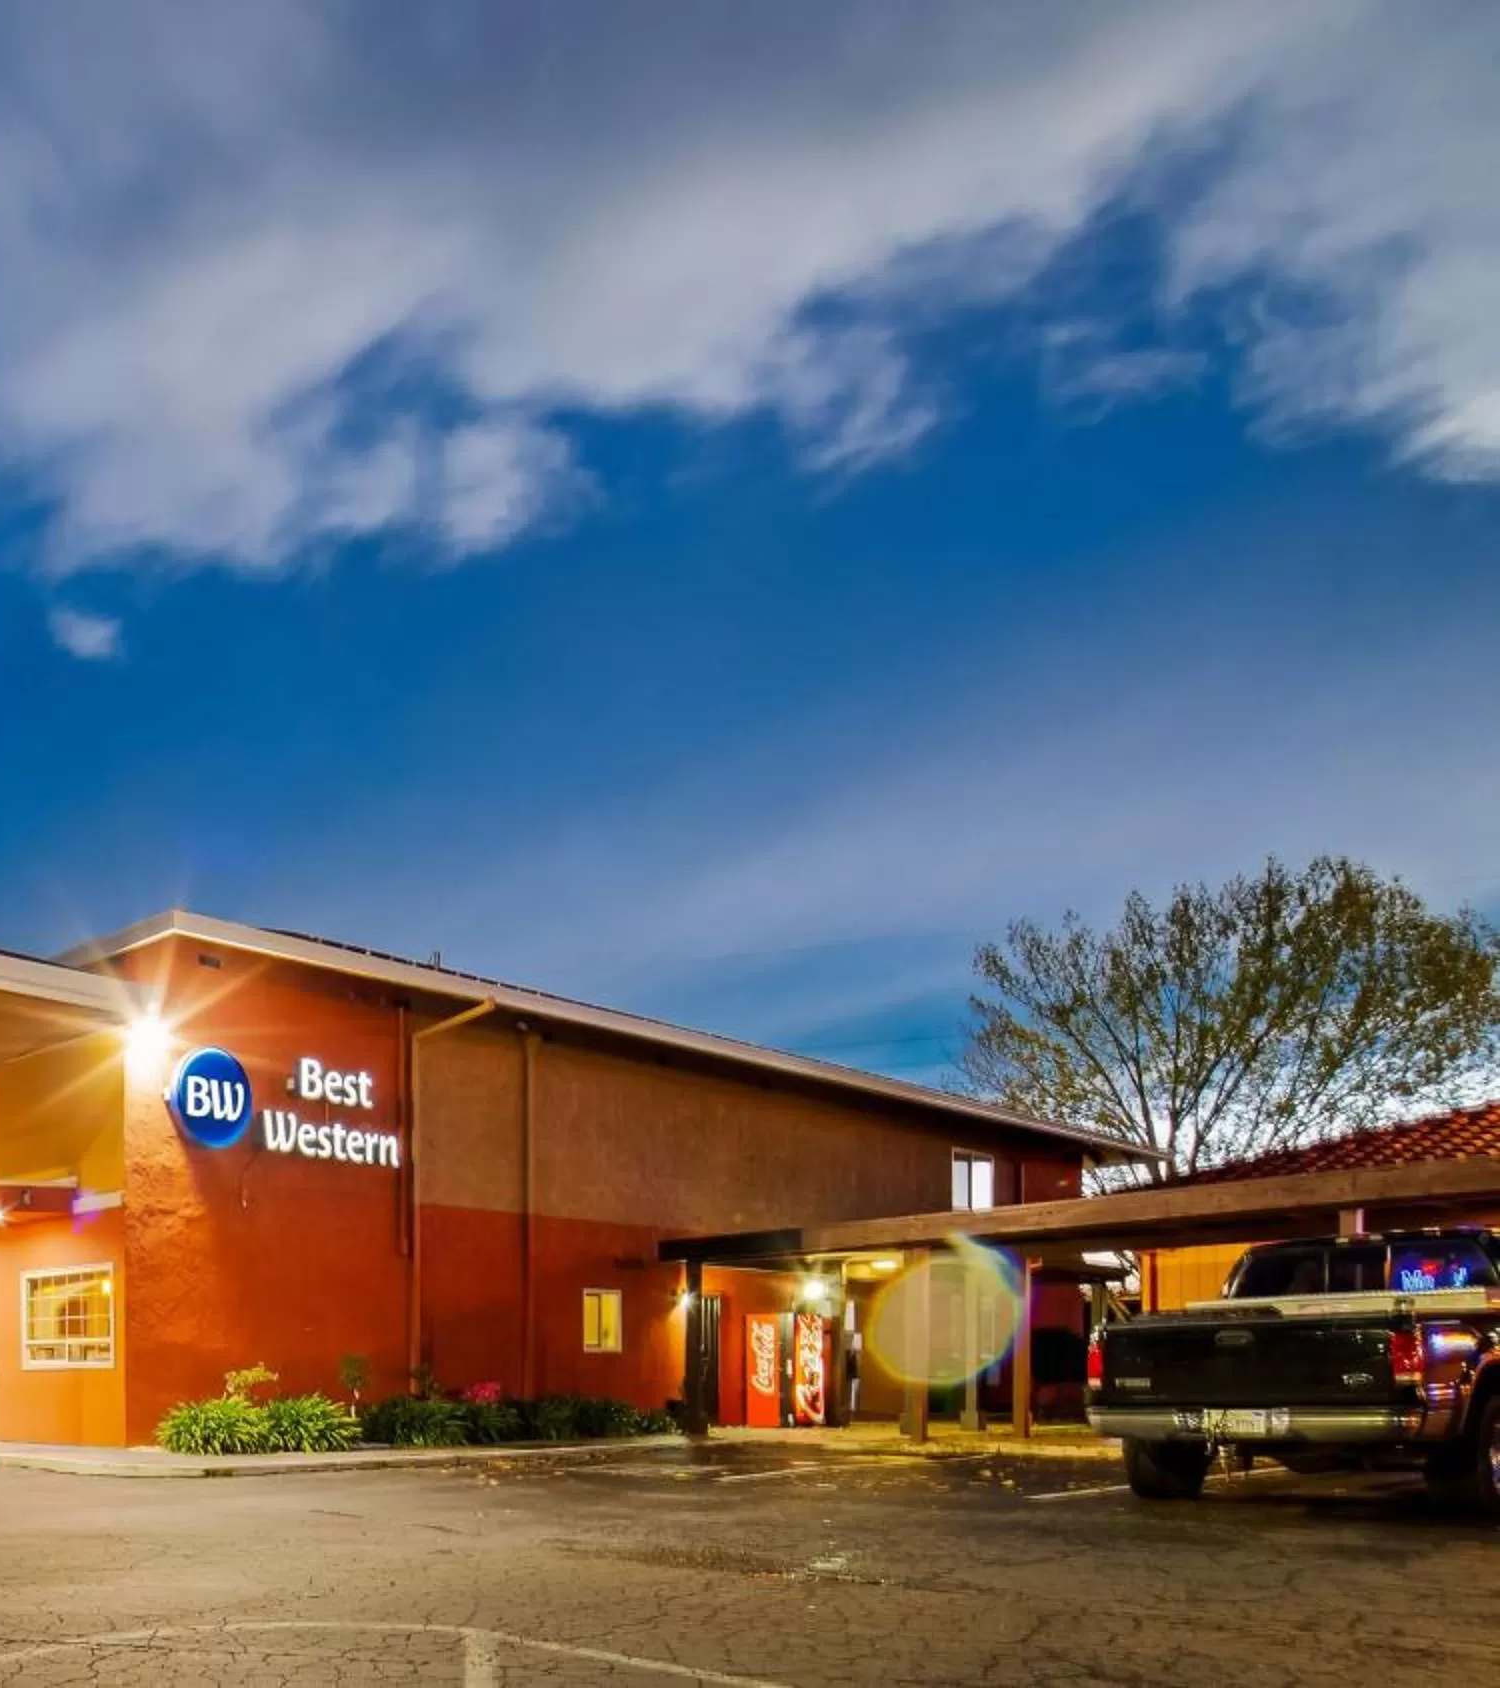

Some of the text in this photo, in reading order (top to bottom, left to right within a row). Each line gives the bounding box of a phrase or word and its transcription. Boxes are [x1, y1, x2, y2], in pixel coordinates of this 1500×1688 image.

[186, 1075, 245, 1122] BW
[300, 1057, 374, 1109] Best
[262, 1108, 400, 1168] Western
